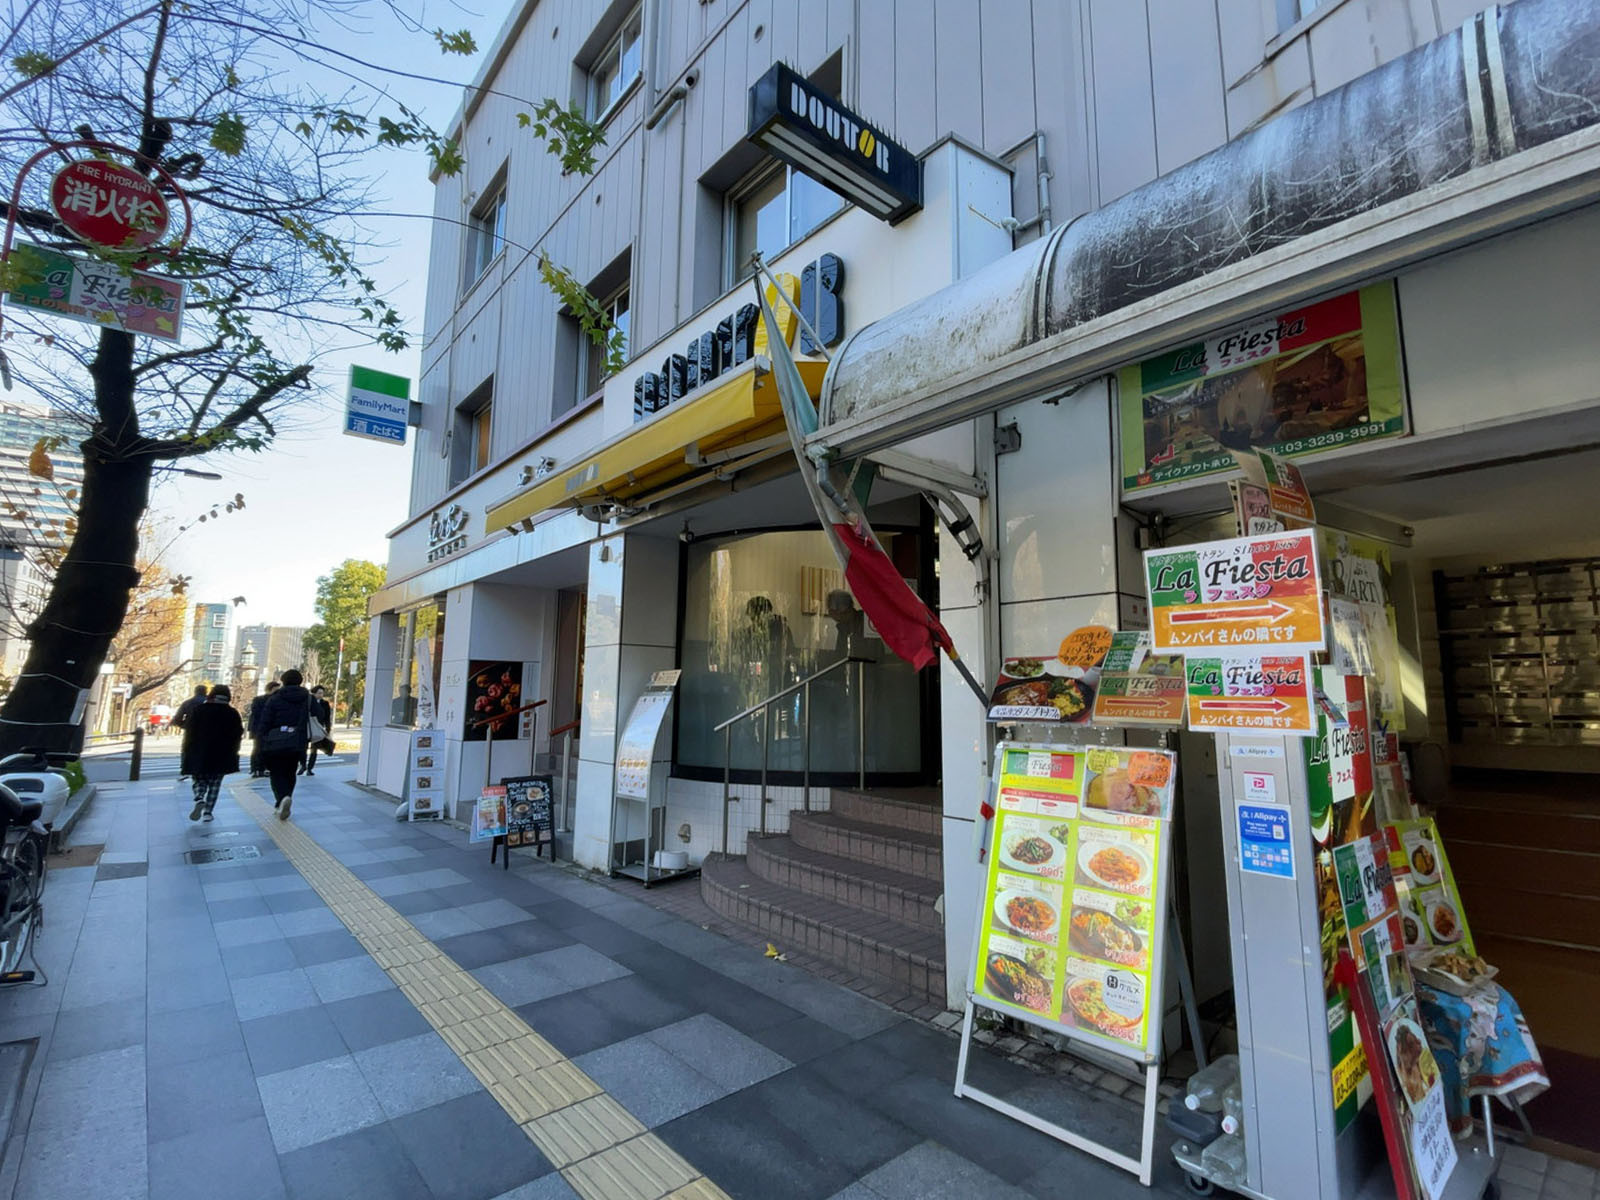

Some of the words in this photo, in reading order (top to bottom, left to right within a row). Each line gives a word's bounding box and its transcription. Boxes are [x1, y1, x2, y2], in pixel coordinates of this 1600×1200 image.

[790, 82, 889, 174] DOUTOR
[76, 164, 101, 179] FIRE
[104, 172, 152, 194] HYDRANT
[62, 176, 161, 233] 消火栓
[1170, 351, 1208, 375] La
[1217, 316, 1306, 359] Fiesta
[352, 395, 406, 415] FamilyMart
[372, 425, 400, 438] たばこ
[1152, 566, 1195, 592] La
[1205, 555, 1309, 587] Fiesta
[1207, 584, 1273, 602] フェスタ
[1131, 678, 1185, 691] Fiesta
[1190, 666, 1218, 686] La
[1227, 665, 1303, 686] Fiesta
